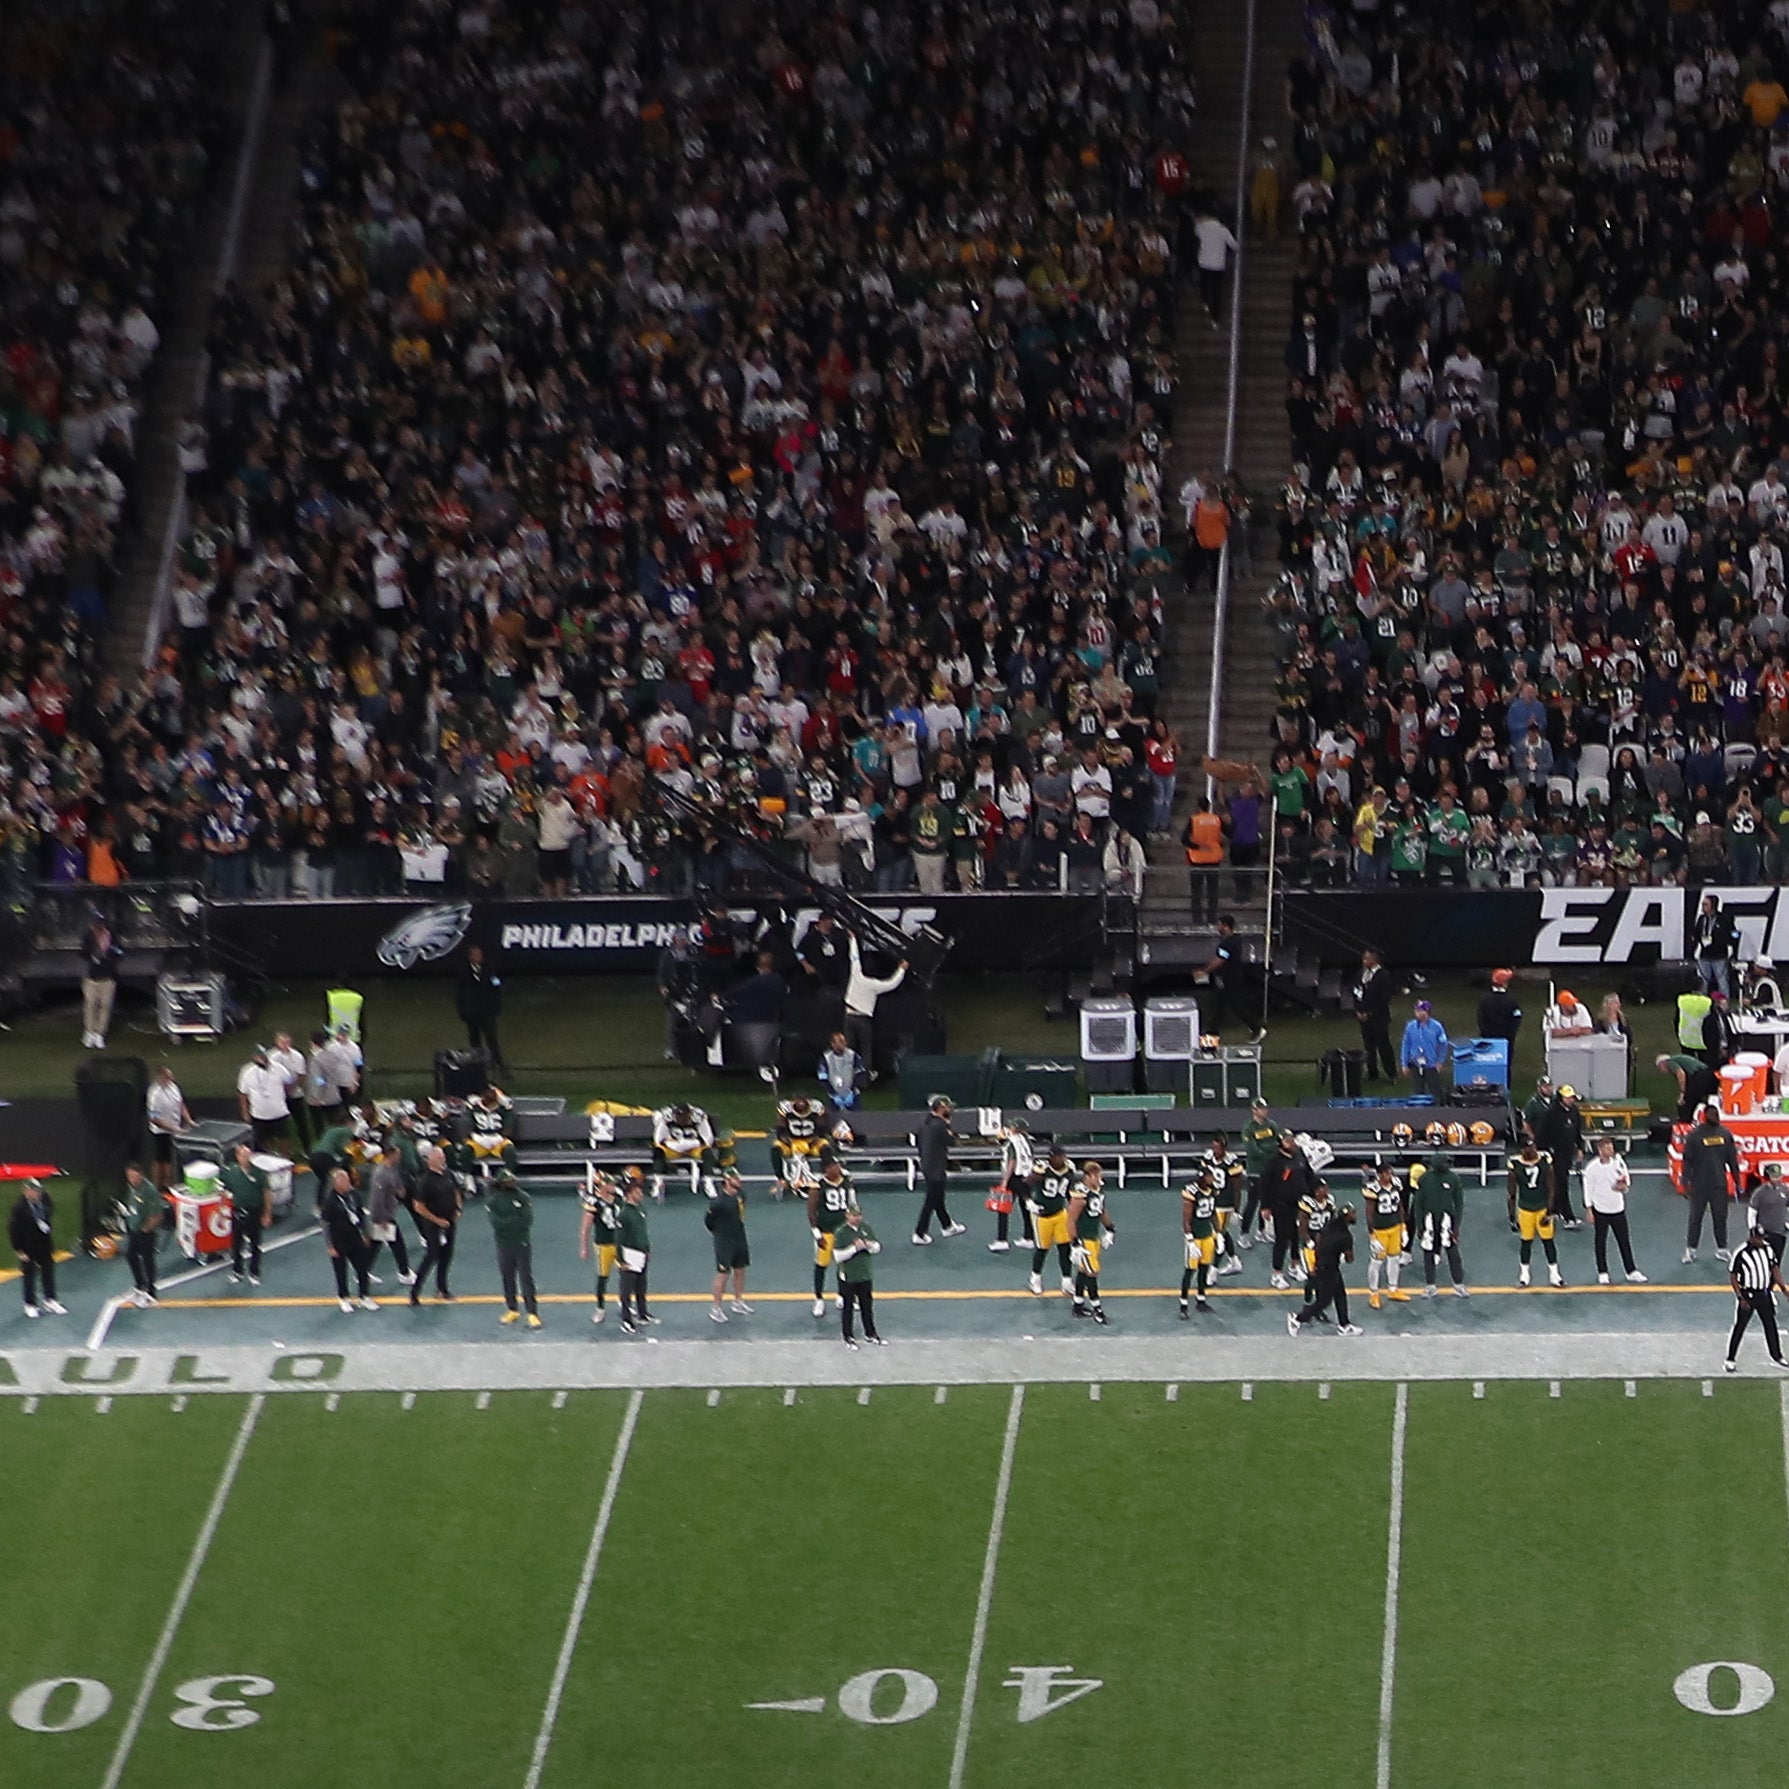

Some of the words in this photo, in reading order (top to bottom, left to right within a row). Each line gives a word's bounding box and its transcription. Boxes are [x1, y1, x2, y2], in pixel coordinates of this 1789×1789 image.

[1662, 527, 1677, 544] 11
[1401, 585, 1419, 608] 10
[1377, 616, 1397, 638] 21
[1616, 686, 1635, 708] 12
[1729, 677, 1748, 698] 18
[1080, 715, 1096, 735] 10
[939, 779, 957, 801] 10
[1732, 811, 1755, 834] 33
[502, 923, 702, 949] PHILADELPH
[1042, 1177, 1069, 1198] 94
[1525, 1165, 1540, 1189] 7
[825, 1188, 850, 1212] 91
[0, 1353, 347, 1384] ULO
